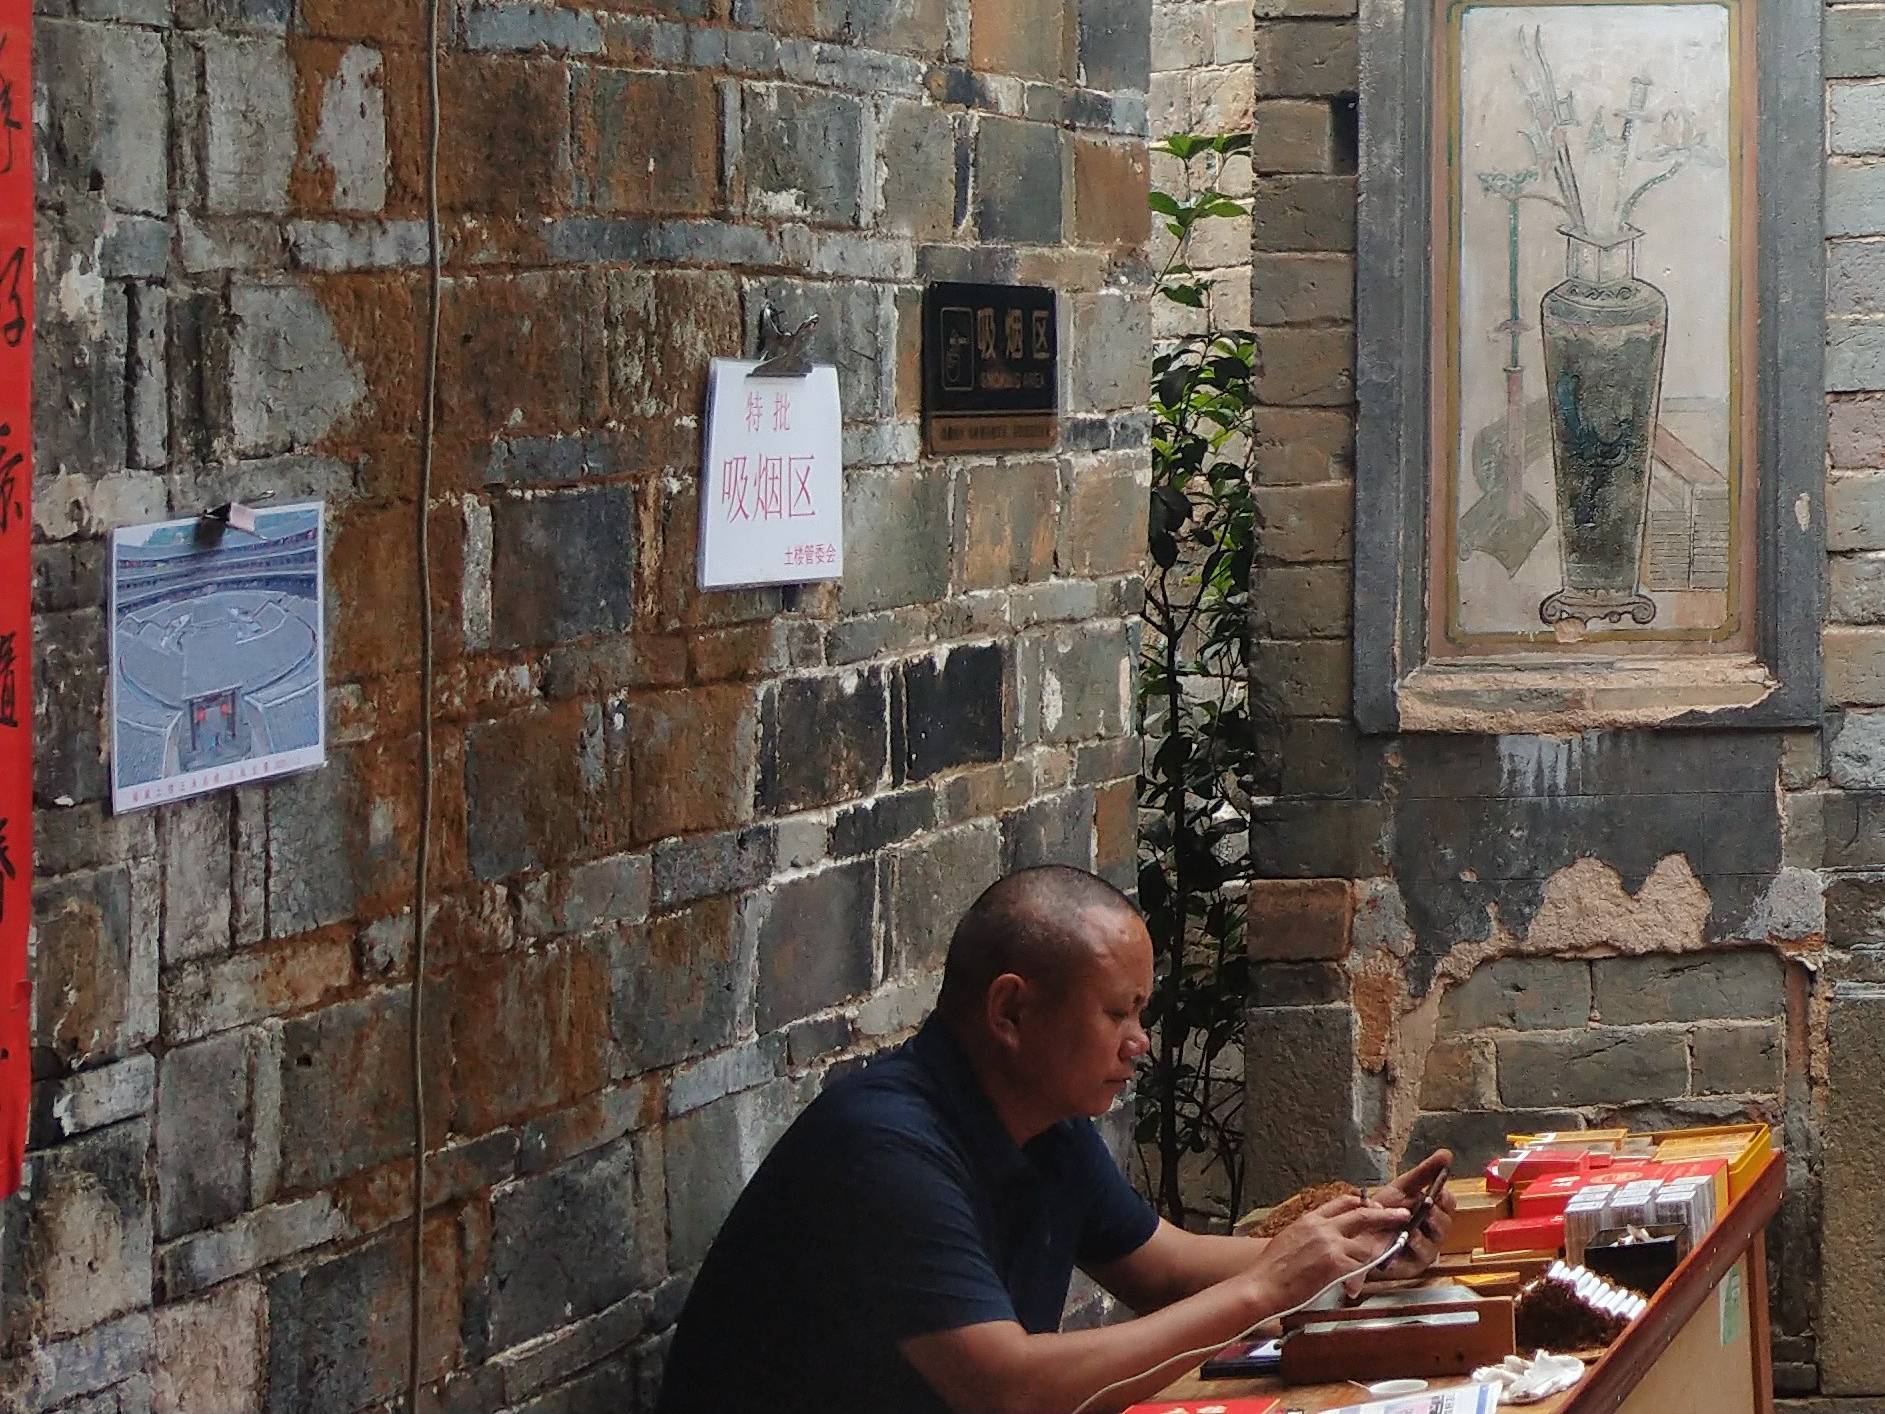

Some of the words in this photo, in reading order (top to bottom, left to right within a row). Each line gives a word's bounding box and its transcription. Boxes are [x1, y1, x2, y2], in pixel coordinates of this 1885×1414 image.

[978, 307, 1050, 360] 吸烟区
[745, 390, 791, 432] 特批
[721, 453, 816, 524] 吸烟区
[784, 543, 837, 566] 土楼管委会
